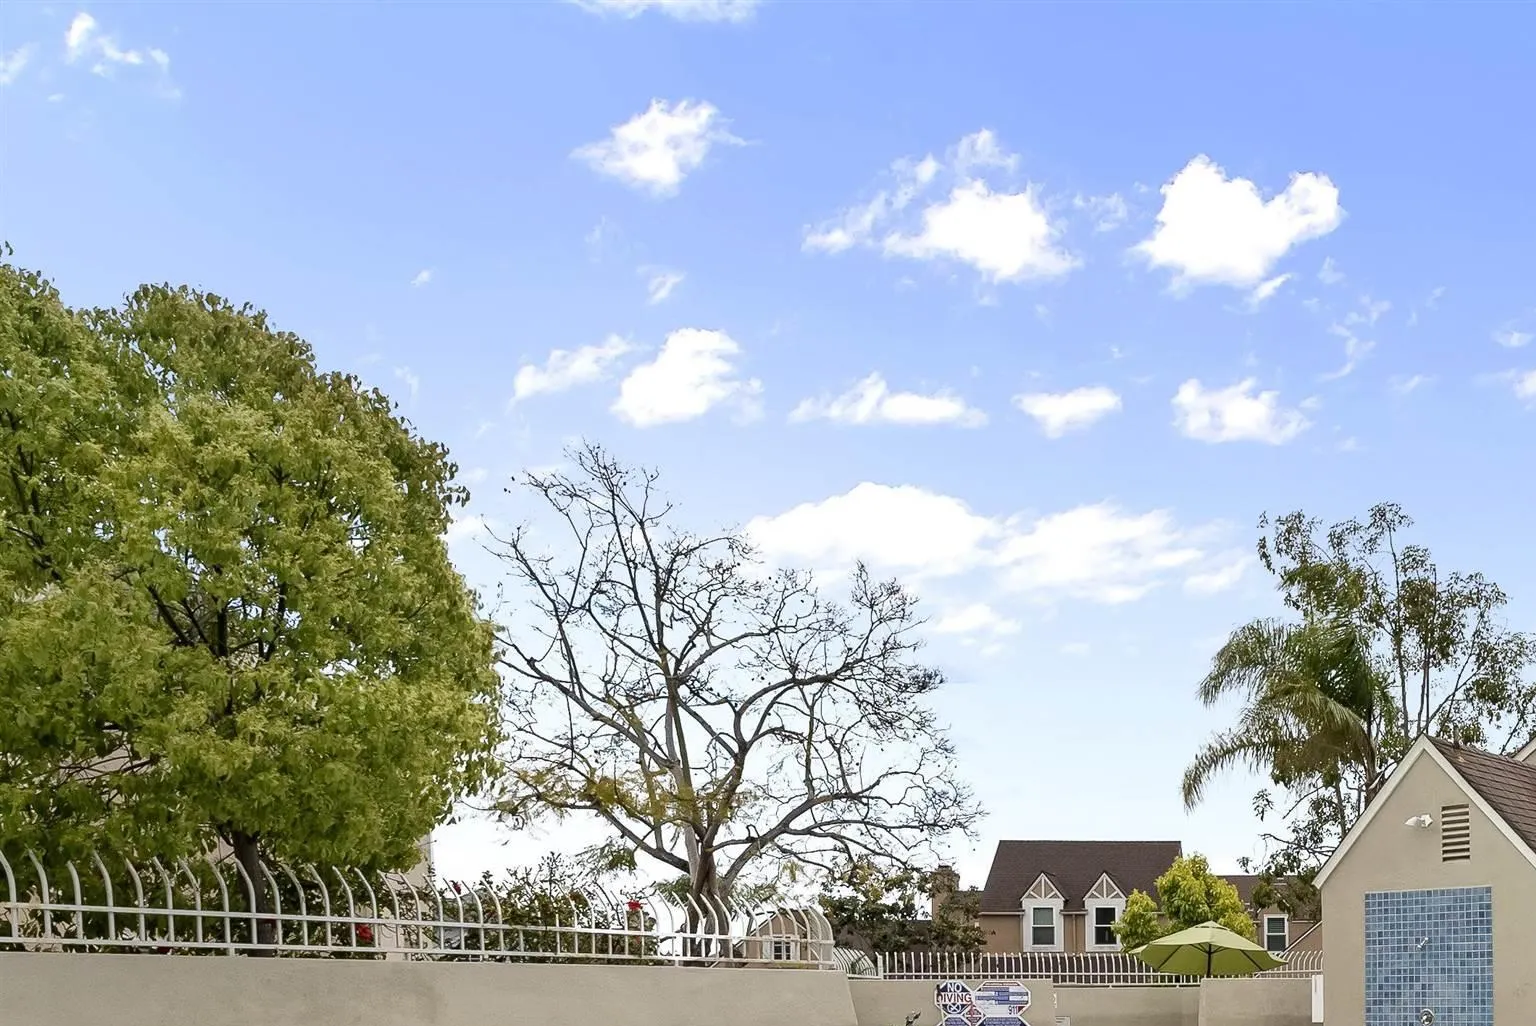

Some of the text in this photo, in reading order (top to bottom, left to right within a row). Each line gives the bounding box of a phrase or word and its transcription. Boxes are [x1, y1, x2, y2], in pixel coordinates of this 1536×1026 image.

[947, 982, 962, 992] NO
[936, 993, 972, 1003] DIVING
[1008, 1005, 1019, 1015] 911
